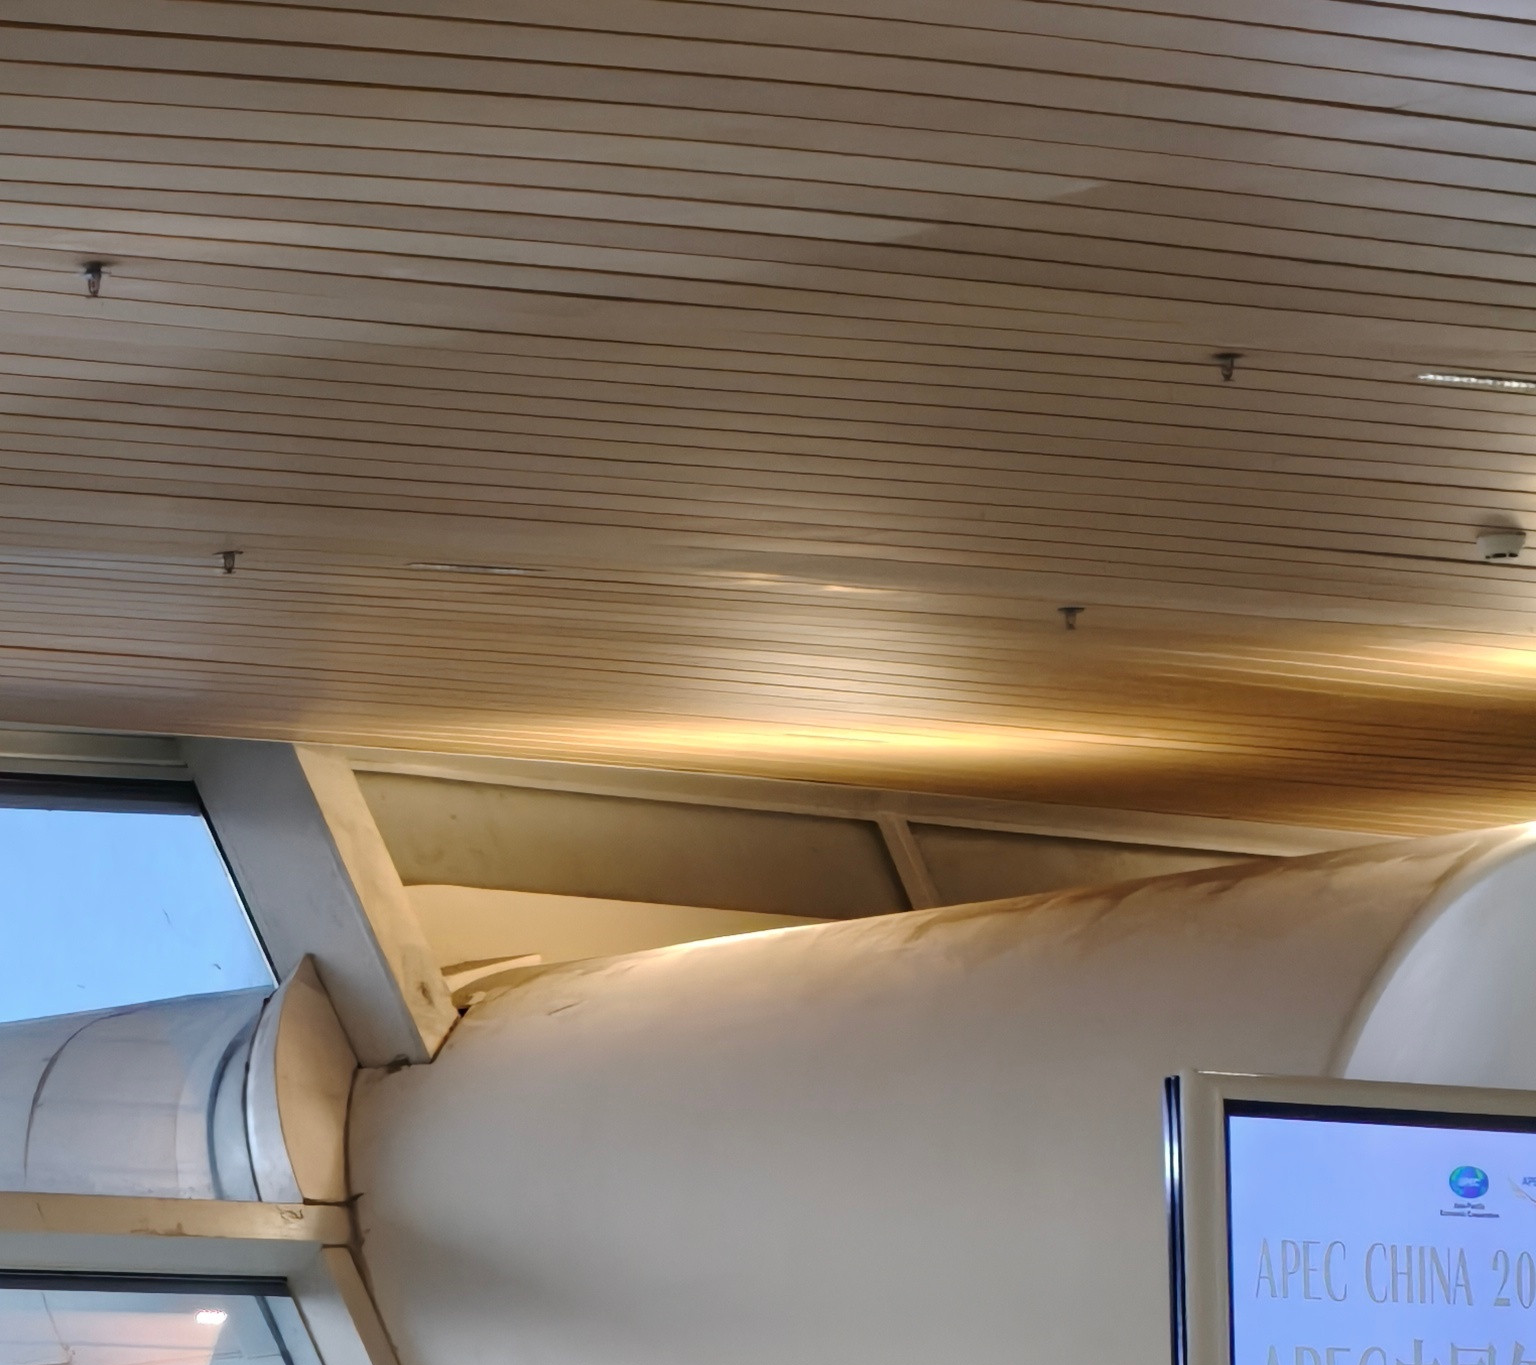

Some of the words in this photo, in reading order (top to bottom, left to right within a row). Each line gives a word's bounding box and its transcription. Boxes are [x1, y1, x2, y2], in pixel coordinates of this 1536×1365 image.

[1255, 1238, 1348, 1302] APEC
[1365, 1242, 1474, 1306] CHINA
[1491, 1249, 1536, 1309] 20
